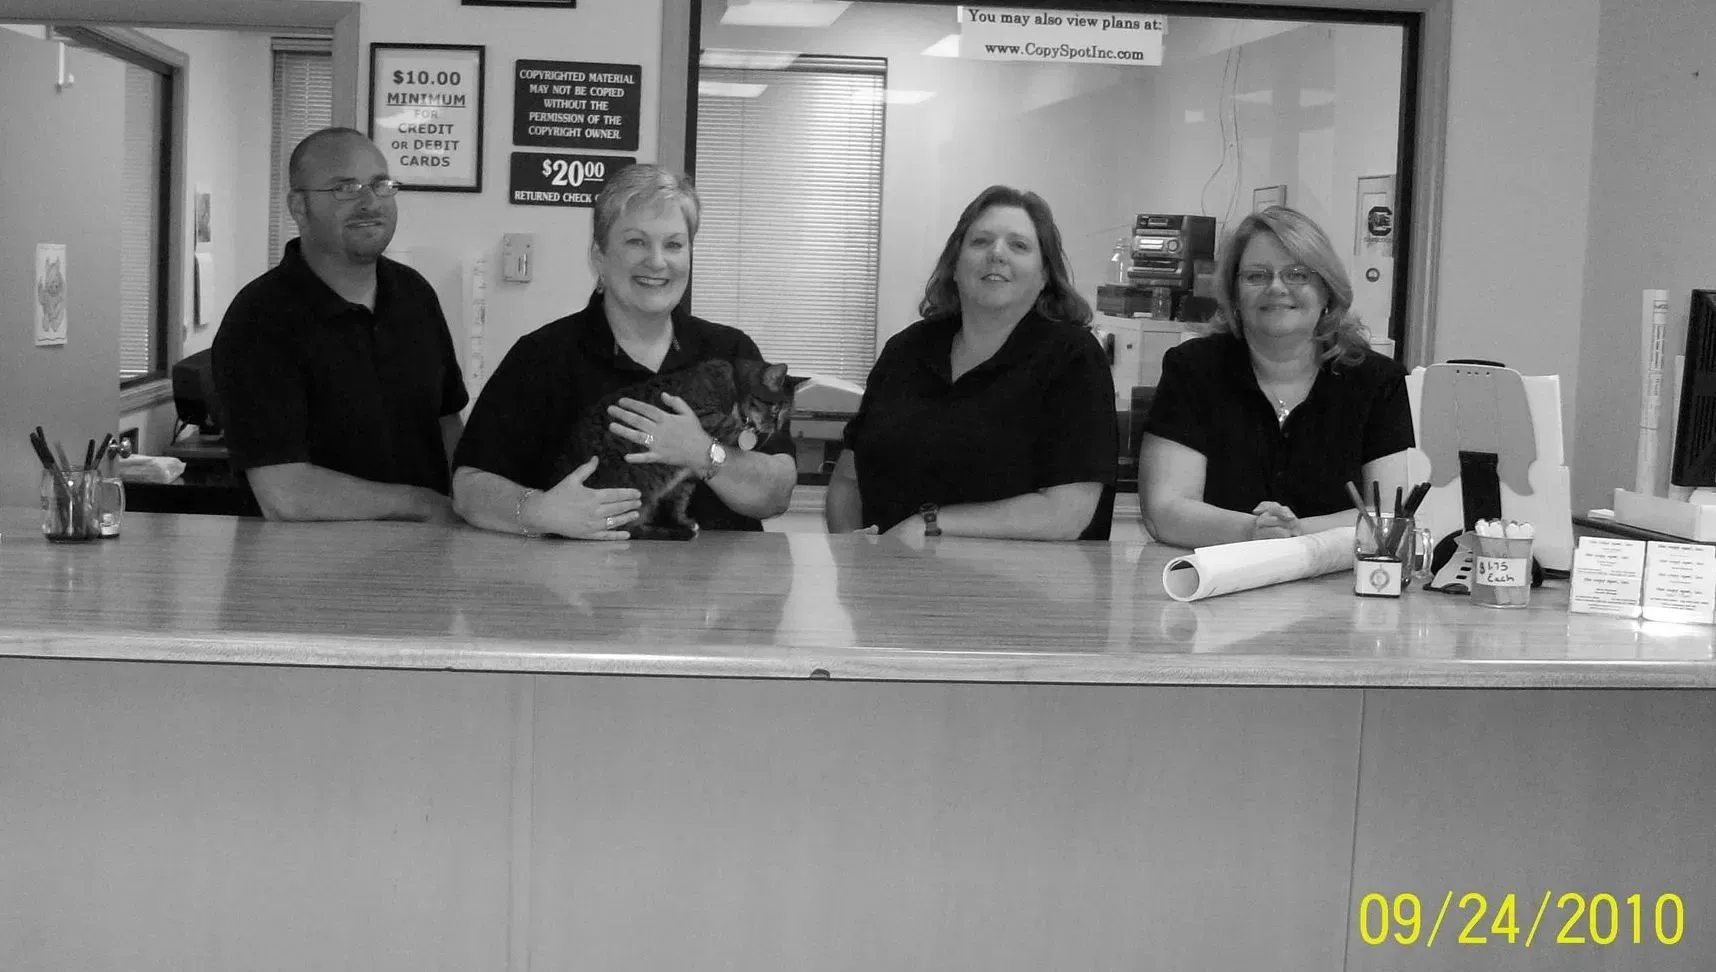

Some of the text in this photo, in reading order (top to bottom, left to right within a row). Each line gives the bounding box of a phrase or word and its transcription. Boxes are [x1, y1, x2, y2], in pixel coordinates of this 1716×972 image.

[968, 9, 1162, 31] You may also view plans at:
[984, 42, 1144, 60] www.CopySpotInc.com
[392, 69, 461, 86] $10.00
[519, 69, 636, 84] COPYRIGHTED MATERIAL
[529, 84, 625, 98] MAY NOT BE COPIED
[386, 92, 466, 106] MINIMUM
[543, 98, 610, 111] WITHOUT THE
[414, 109, 439, 119] FOR
[529, 111, 623, 126] PERMISSION OF THE
[398, 123, 455, 135] CREDIT
[527, 125, 622, 140] COPYRIGHT OWNER.
[414, 139, 460, 151] DEBIT
[400, 155, 451, 167] CARDS
[514, 190, 561, 202] RETURNED
[562, 192, 593, 203] CHECK
[1487, 572, 1515, 583] Each
